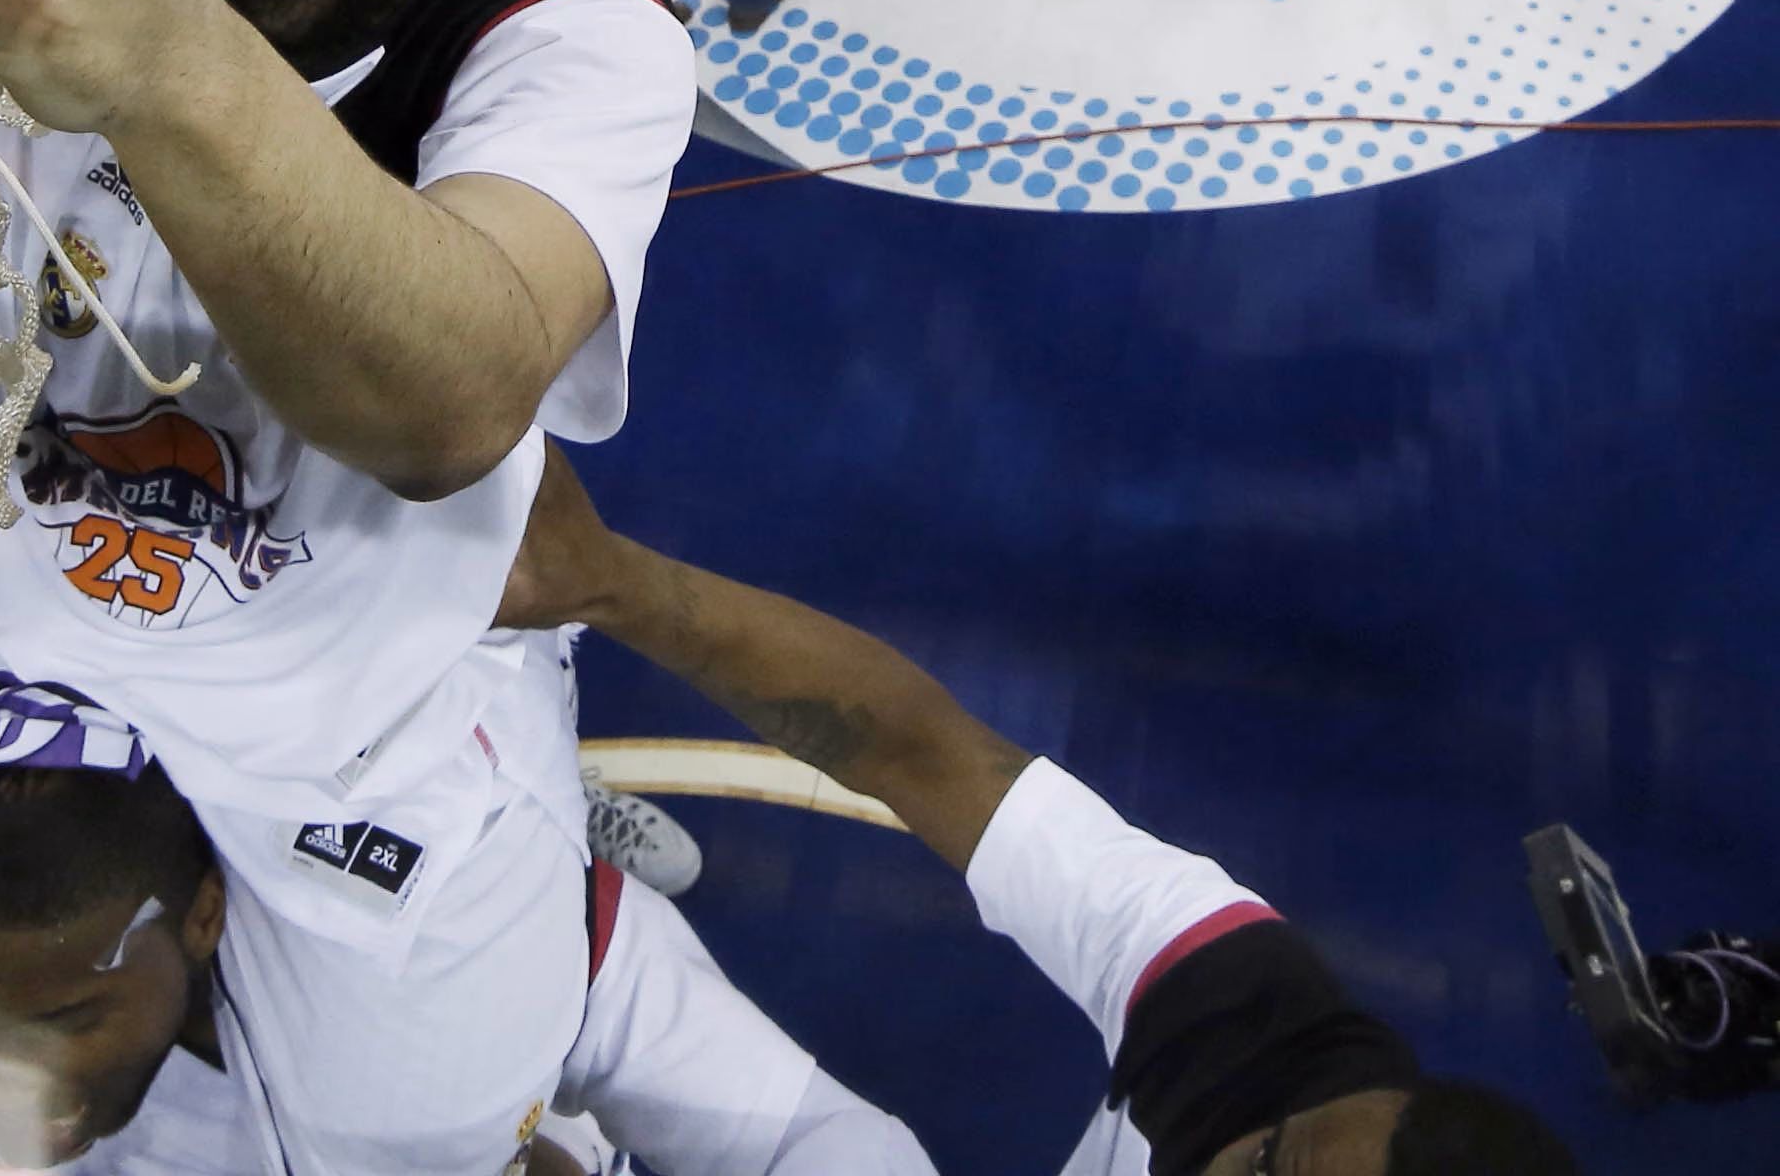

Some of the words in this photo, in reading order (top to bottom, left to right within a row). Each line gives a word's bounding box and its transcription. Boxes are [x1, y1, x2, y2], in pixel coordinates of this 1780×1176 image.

[87, 168, 145, 227] adidas
[120, 478, 178, 511] DEL
[187, 489, 245, 525] RE
[62, 513, 197, 616] 25
[304, 833, 347, 860] adidas
[369, 845, 399, 873] 2XL
